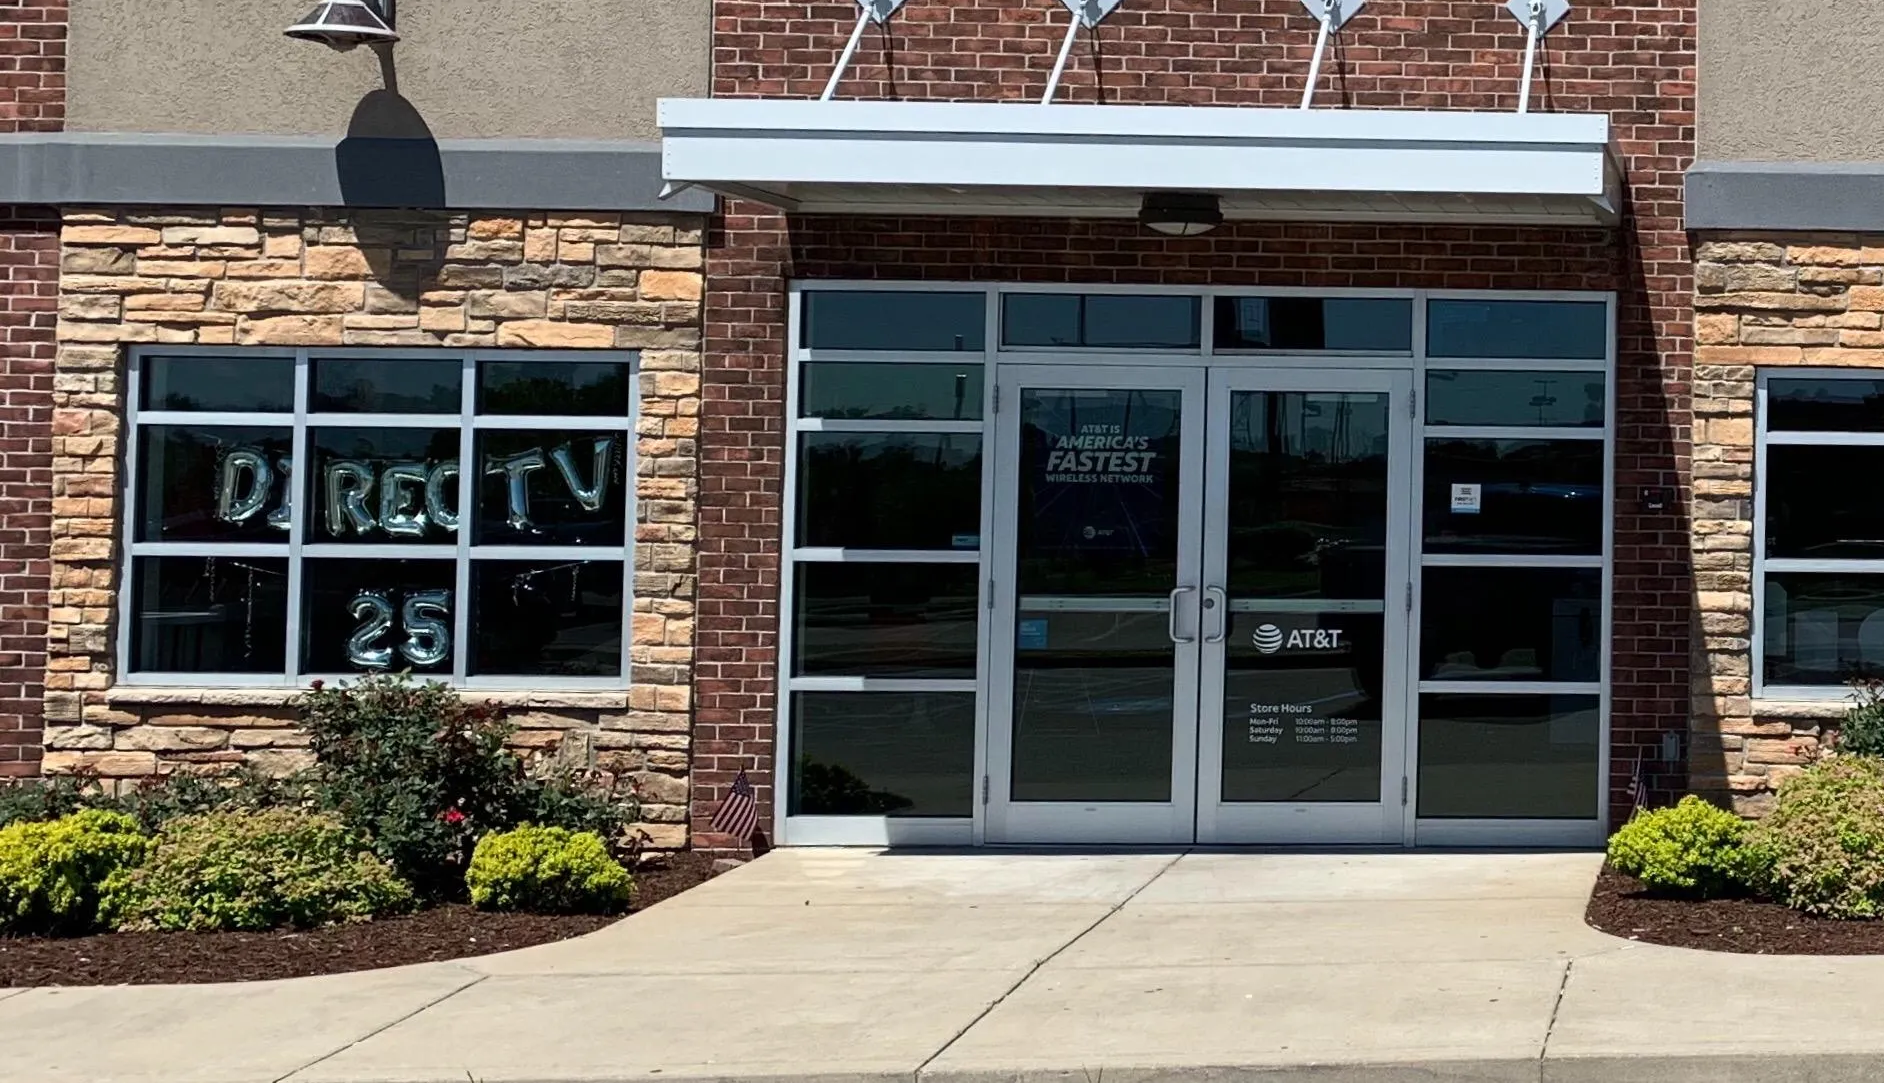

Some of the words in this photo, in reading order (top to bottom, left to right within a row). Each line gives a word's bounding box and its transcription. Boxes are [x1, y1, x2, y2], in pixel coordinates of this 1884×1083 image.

[1081, 424, 1109, 434] AT&T
[1110, 424, 1121, 434] IS
[1055, 436, 1150, 450] AMERICA'S
[1046, 451, 1157, 472] FASTEST
[1045, 474, 1098, 483] WIRELESS
[1100, 474, 1153, 484] NETWORK
[219, 437, 613, 537] DIRECTV
[346, 587, 451, 669] 25
[1286, 629, 1343, 649] AT&T
[1250, 703, 1280, 714] Store
[1281, 703, 1312, 714] Hours
[1249, 718, 1279, 726] Mon-Fri
[1249, 726, 1284, 735] Saturday
[1249, 735, 1278, 744] Sunday
